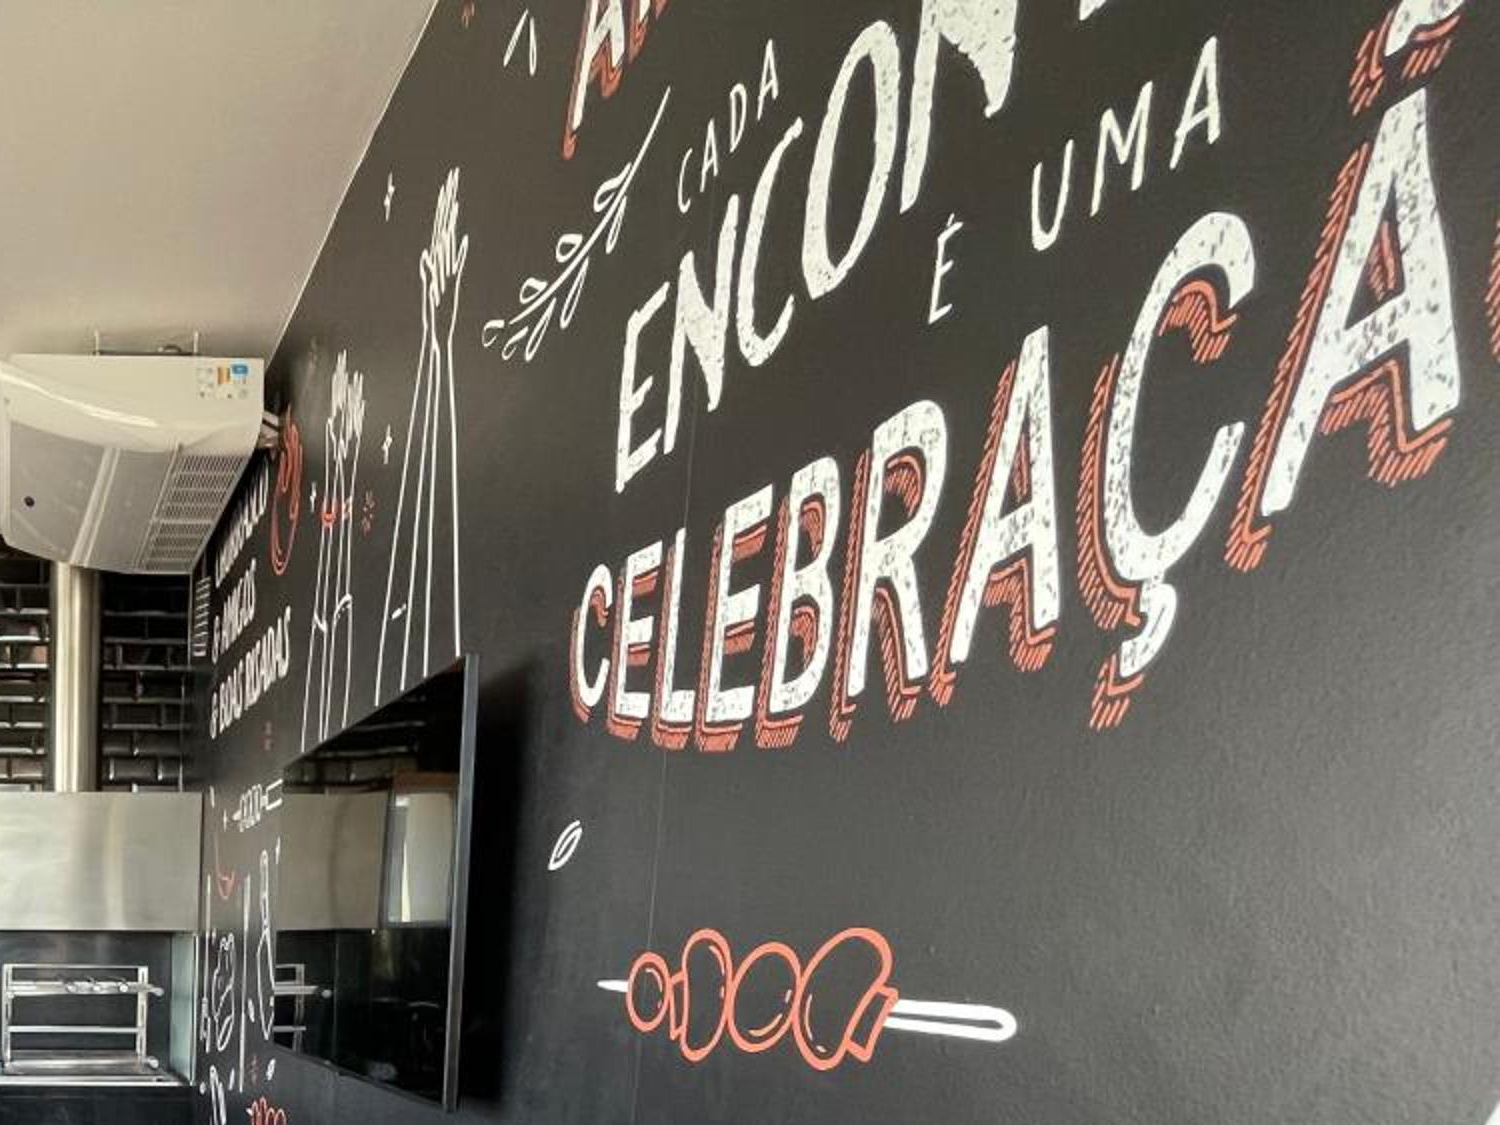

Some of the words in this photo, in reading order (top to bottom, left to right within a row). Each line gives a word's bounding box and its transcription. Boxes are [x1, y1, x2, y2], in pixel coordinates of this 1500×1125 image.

[677, 40, 779, 214] CADA
[928, 213, 964, 325] É
[1030, 36, 1221, 252] UMA
[568, 0, 1500, 750] CELEBRAÇÃ
[219, 659, 243, 734] BOAS
[244, 605, 292, 711] RISADAS
